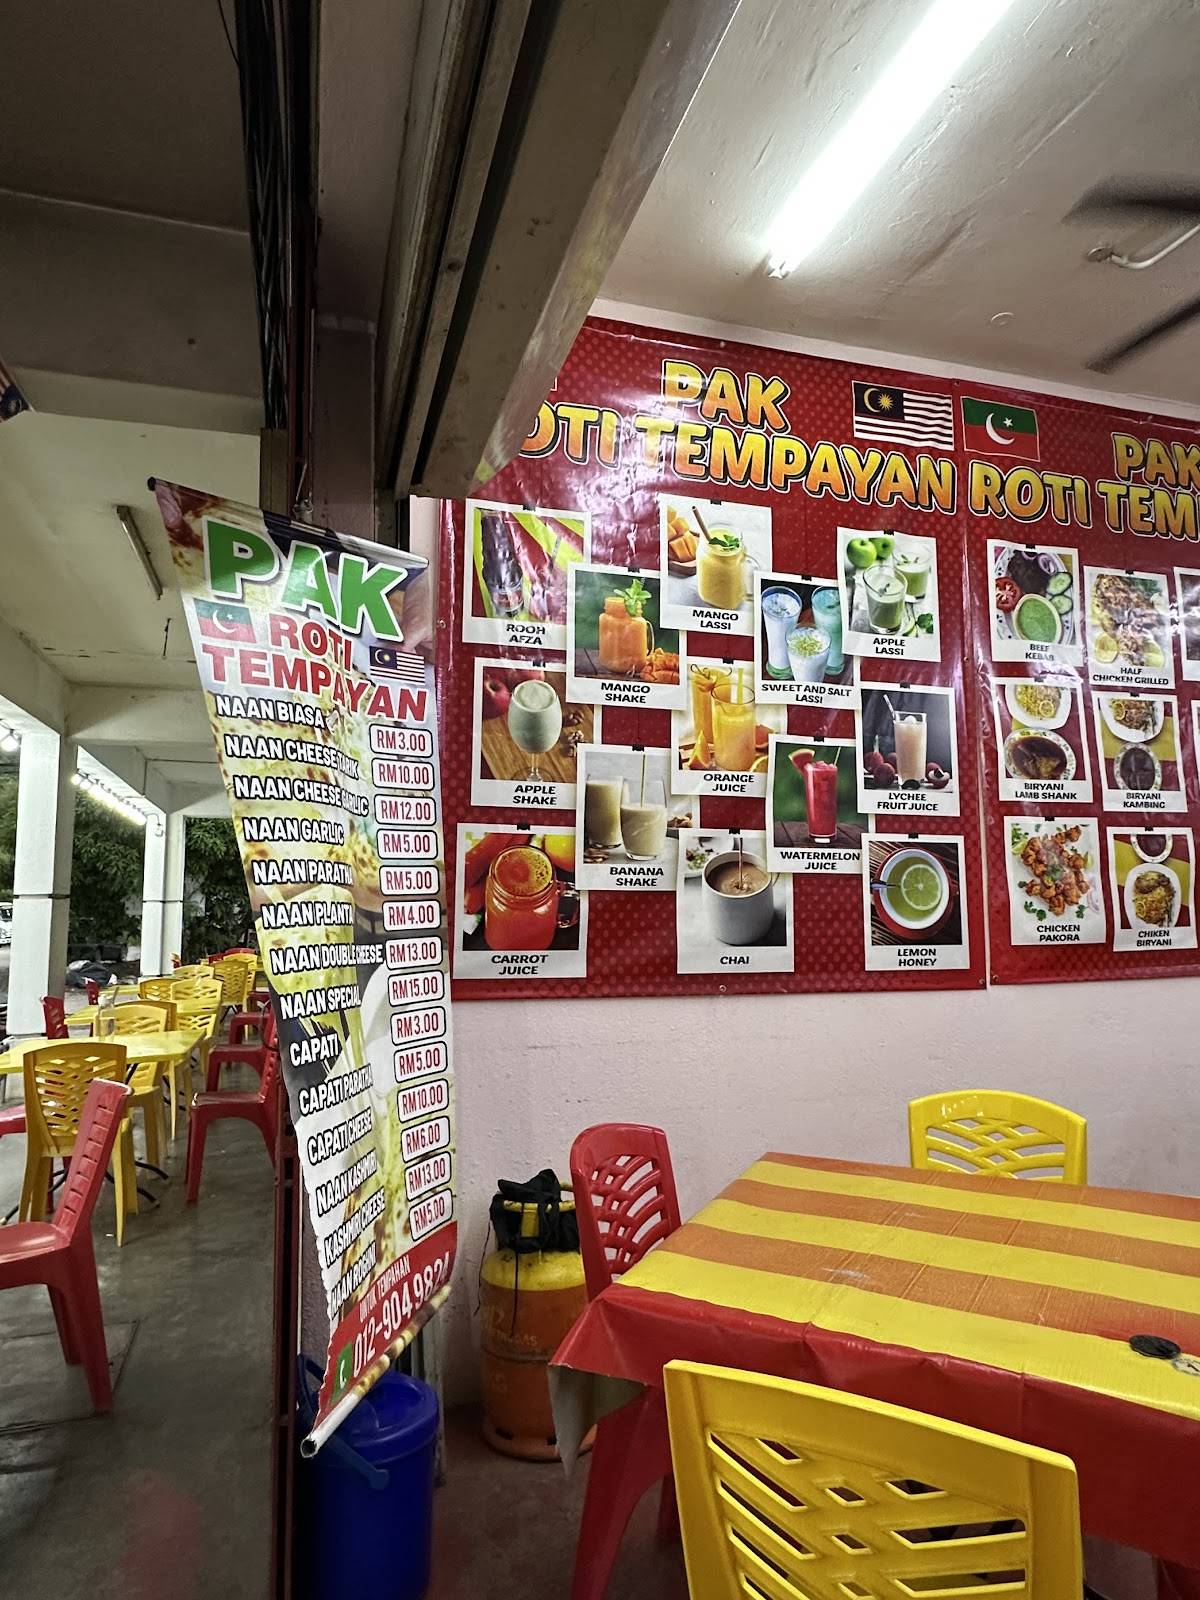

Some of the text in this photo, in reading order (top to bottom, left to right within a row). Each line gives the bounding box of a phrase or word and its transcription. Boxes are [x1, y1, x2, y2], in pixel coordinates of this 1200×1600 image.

[662, 359, 790, 433] PAK
[519, 400, 956, 515] OTI TEMPAYAN
[1112, 432, 1200, 491] PAK
[968, 460, 1200, 543] ROTI TEM
[205, 517, 407, 641] PAK
[692, 609, 739, 621] MANGO
[506, 624, 546, 635] ROOH
[700, 620, 731, 630] LASSI
[269, 613, 352, 672] ROTI
[872, 637, 906, 647] APPLE
[875, 646, 904, 656] LASSI
[1121, 667, 1143, 676] HALF
[202, 644, 427, 721] TEMPAYAN
[1093, 674, 1169, 686] CHICKEN GRILLED
[600, 682, 651, 694] MANGO
[761, 683, 852, 698] SWEET AND SALT
[605, 693, 647, 704] SHAKE
[795, 693, 823, 704] LASSI
[215, 695, 327, 730] NAAN BIASA
[224, 734, 284, 759] NAAN
[284, 739, 338, 770] CHEESE
[703, 773, 755, 784] ORANGE
[233, 775, 292, 800] NAAN
[293, 778, 343, 807] CHEESE
[514, 784, 556, 795] APPLE
[712, 782, 747, 793] JUICE
[1024, 782, 1064, 791] BIRYANI
[512, 795, 557, 806] SHAKE
[888, 792, 927, 801] LYCHEE
[1015, 791, 1077, 800] LAMB SHANK
[1126, 792, 1161, 800] BIRYANI
[877, 801, 938, 812] FRUIT JUICE
[1123, 800, 1165, 809] KAMBING
[243, 817, 345, 846] NAAN GARLIC
[780, 851, 860, 861] WATERMELON
[609, 866, 664, 876] BANANA
[805, 861, 837, 871] JUICE
[252, 859, 307, 885] NAAN
[616, 877, 658, 887] SHAKE
[261, 901, 353, 929] NAAN PLANTA
[1037, 924, 1081, 933] CHICKEN
[1138, 930, 1170, 938] CHIKEN
[1039, 933, 1080, 942] PAKORA
[1137, 938, 1172, 947] BIRYANI
[897, 947, 937, 957] LEMON
[270, 947, 321, 975] NAAN
[322, 942, 356, 969] DOUBLE
[491, 954, 548, 964] CARROT
[720, 955, 750, 966] CHAI
[898, 958, 937, 968] HONEY
[499, 965, 539, 975] JUICE
[280, 985, 362, 1020] NAAN SPECIAL
[289, 1032, 340, 1067] CAPATI
[298, 1076, 344, 1117] CAPATI
[307, 1118, 349, 1166] CAPATI
[315, 1168, 349, 1218] NAAN
[361, 1185, 386, 1231] CHEESE
